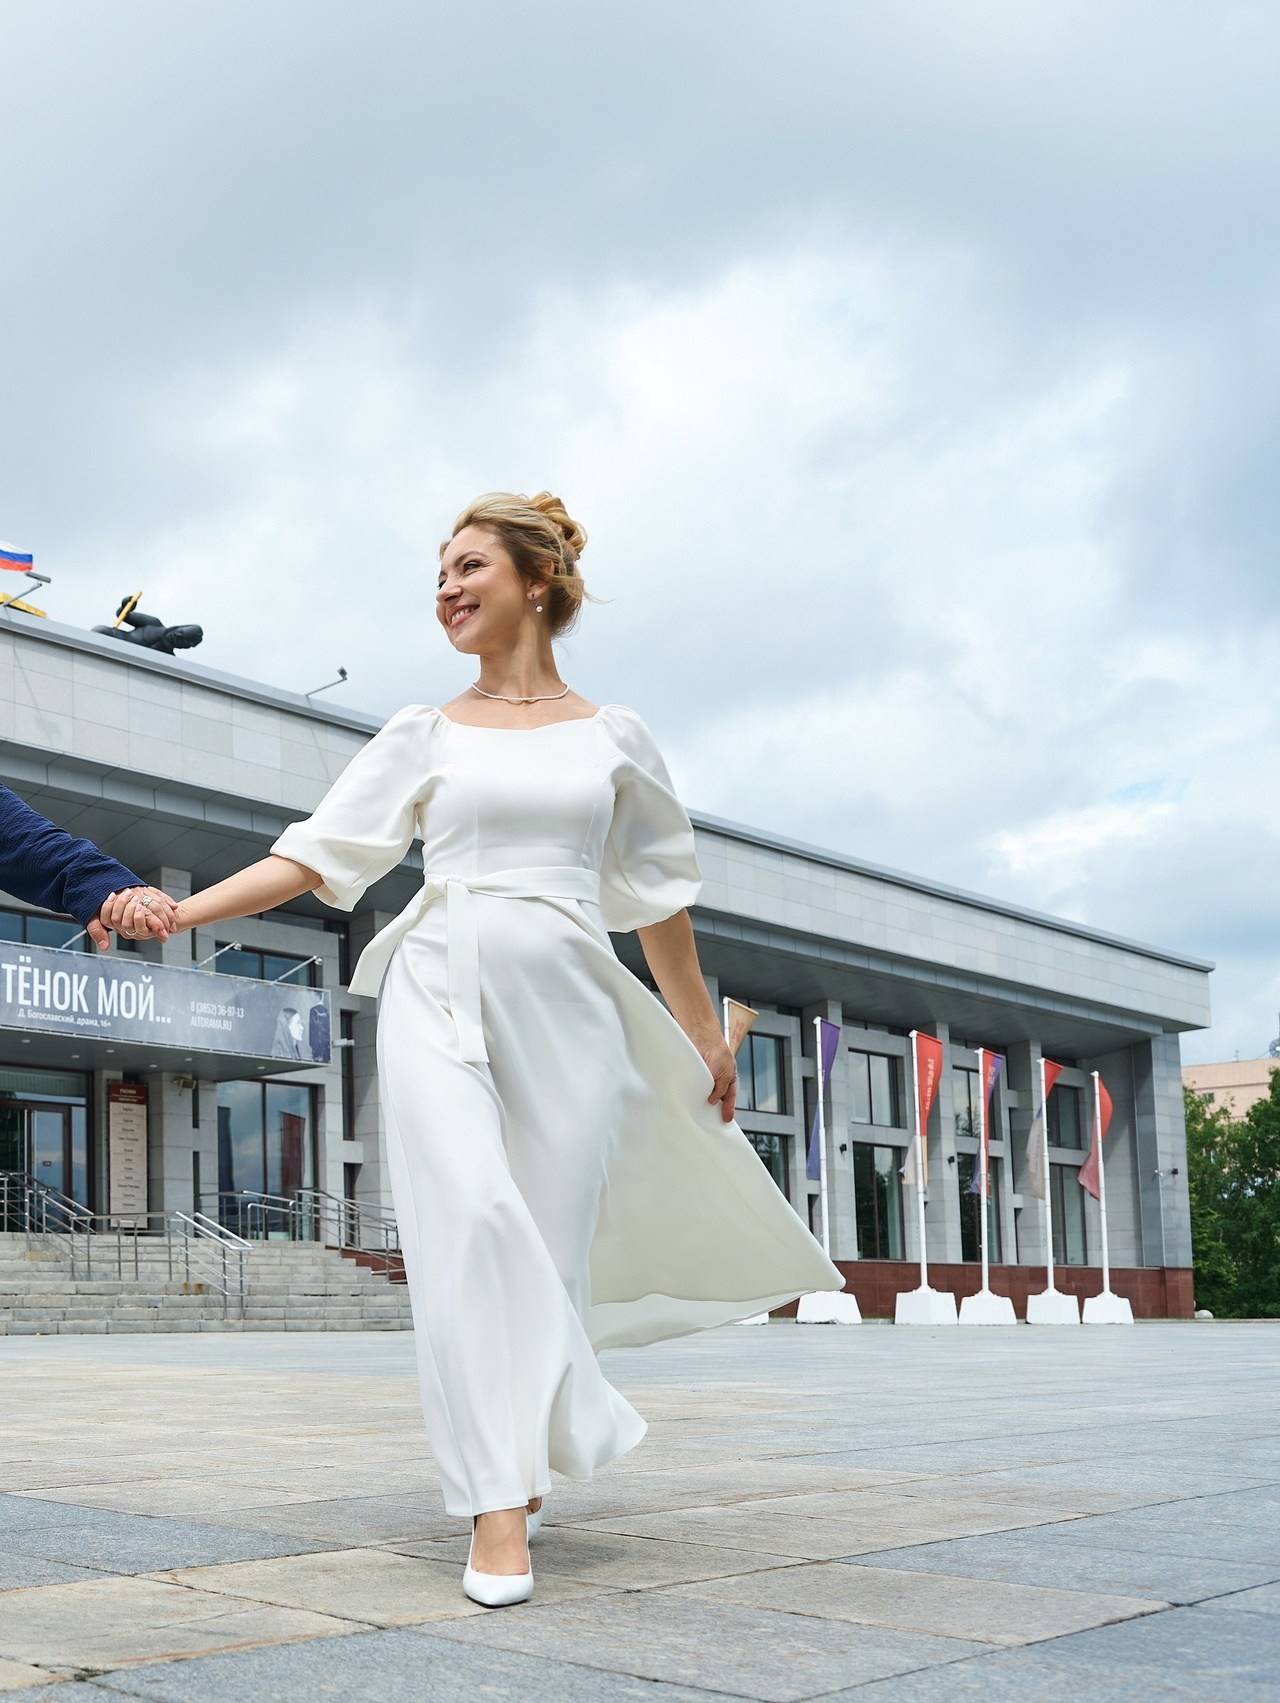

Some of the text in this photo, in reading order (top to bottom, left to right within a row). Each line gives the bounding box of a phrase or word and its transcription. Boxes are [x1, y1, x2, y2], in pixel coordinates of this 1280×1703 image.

[98, 974, 172, 1025] МОЙ...
[190, 1001, 196, 1012] 8
[17, 1008, 26, 1018] Д.
[100, 1019, 112, 1028] 16+
